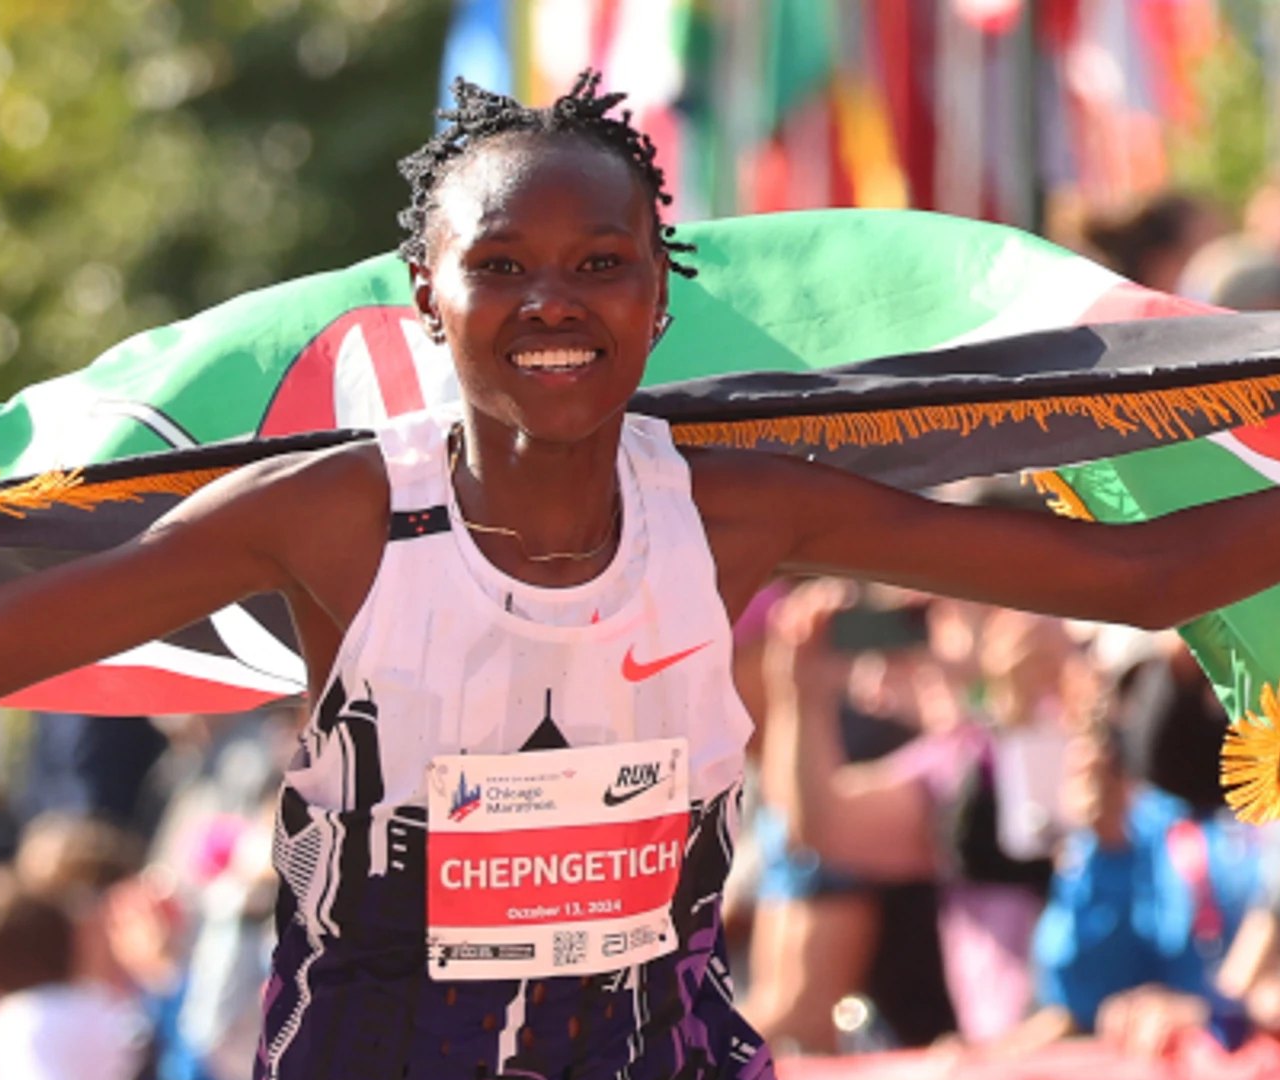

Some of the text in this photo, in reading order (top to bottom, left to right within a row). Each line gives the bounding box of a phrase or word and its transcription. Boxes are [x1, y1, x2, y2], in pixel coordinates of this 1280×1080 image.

[616, 762, 660, 787] RUN
[486, 786, 542, 802] Chicago
[440, 841, 678, 889] CHEPNGETICH
[506, 900, 622, 920] October 13, 2024
